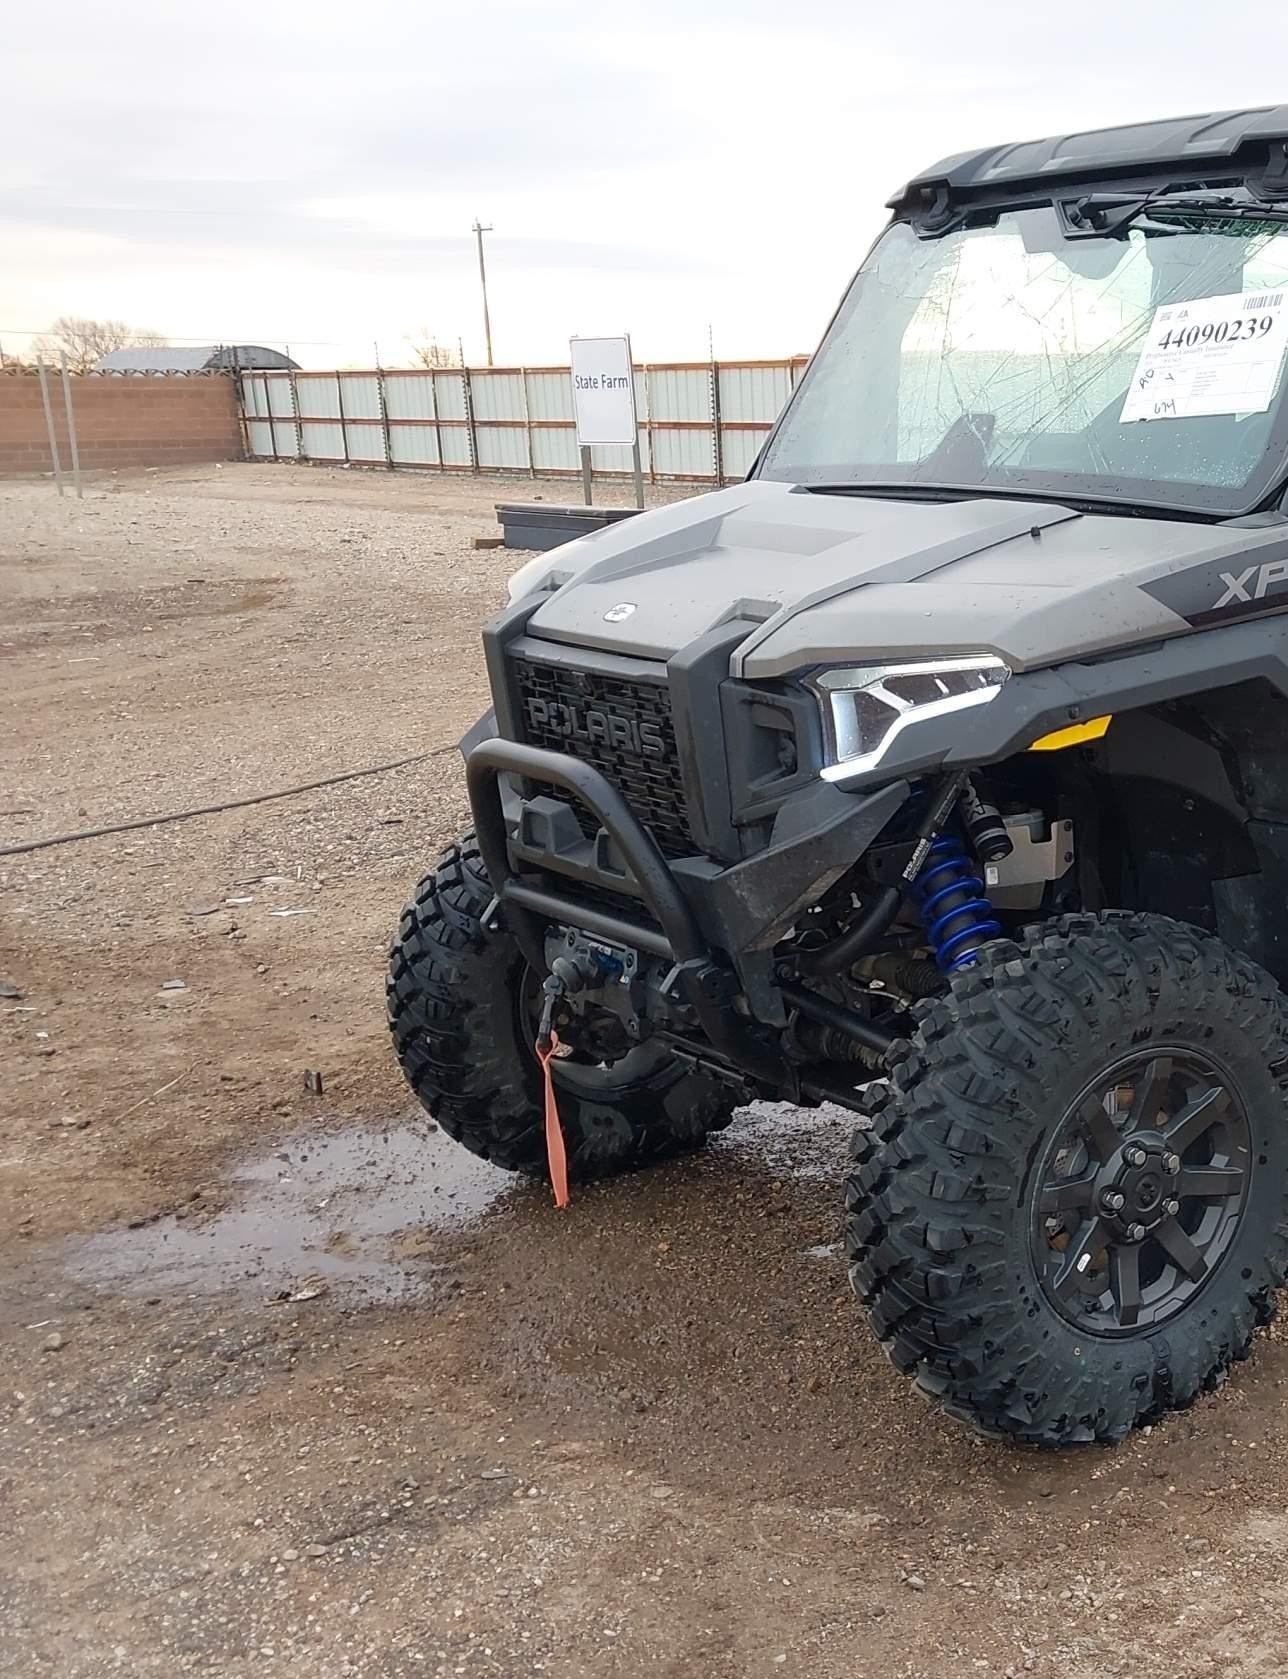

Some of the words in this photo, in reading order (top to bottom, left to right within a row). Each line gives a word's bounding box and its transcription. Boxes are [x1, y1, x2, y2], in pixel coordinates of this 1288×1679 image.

[1158, 315, 1273, 349] 44090239
[575, 374, 599, 389] State
[601, 374, 629, 389] Farm
[527, 696, 666, 757] POLARIS
[902, 838, 927, 878] POLARIS
